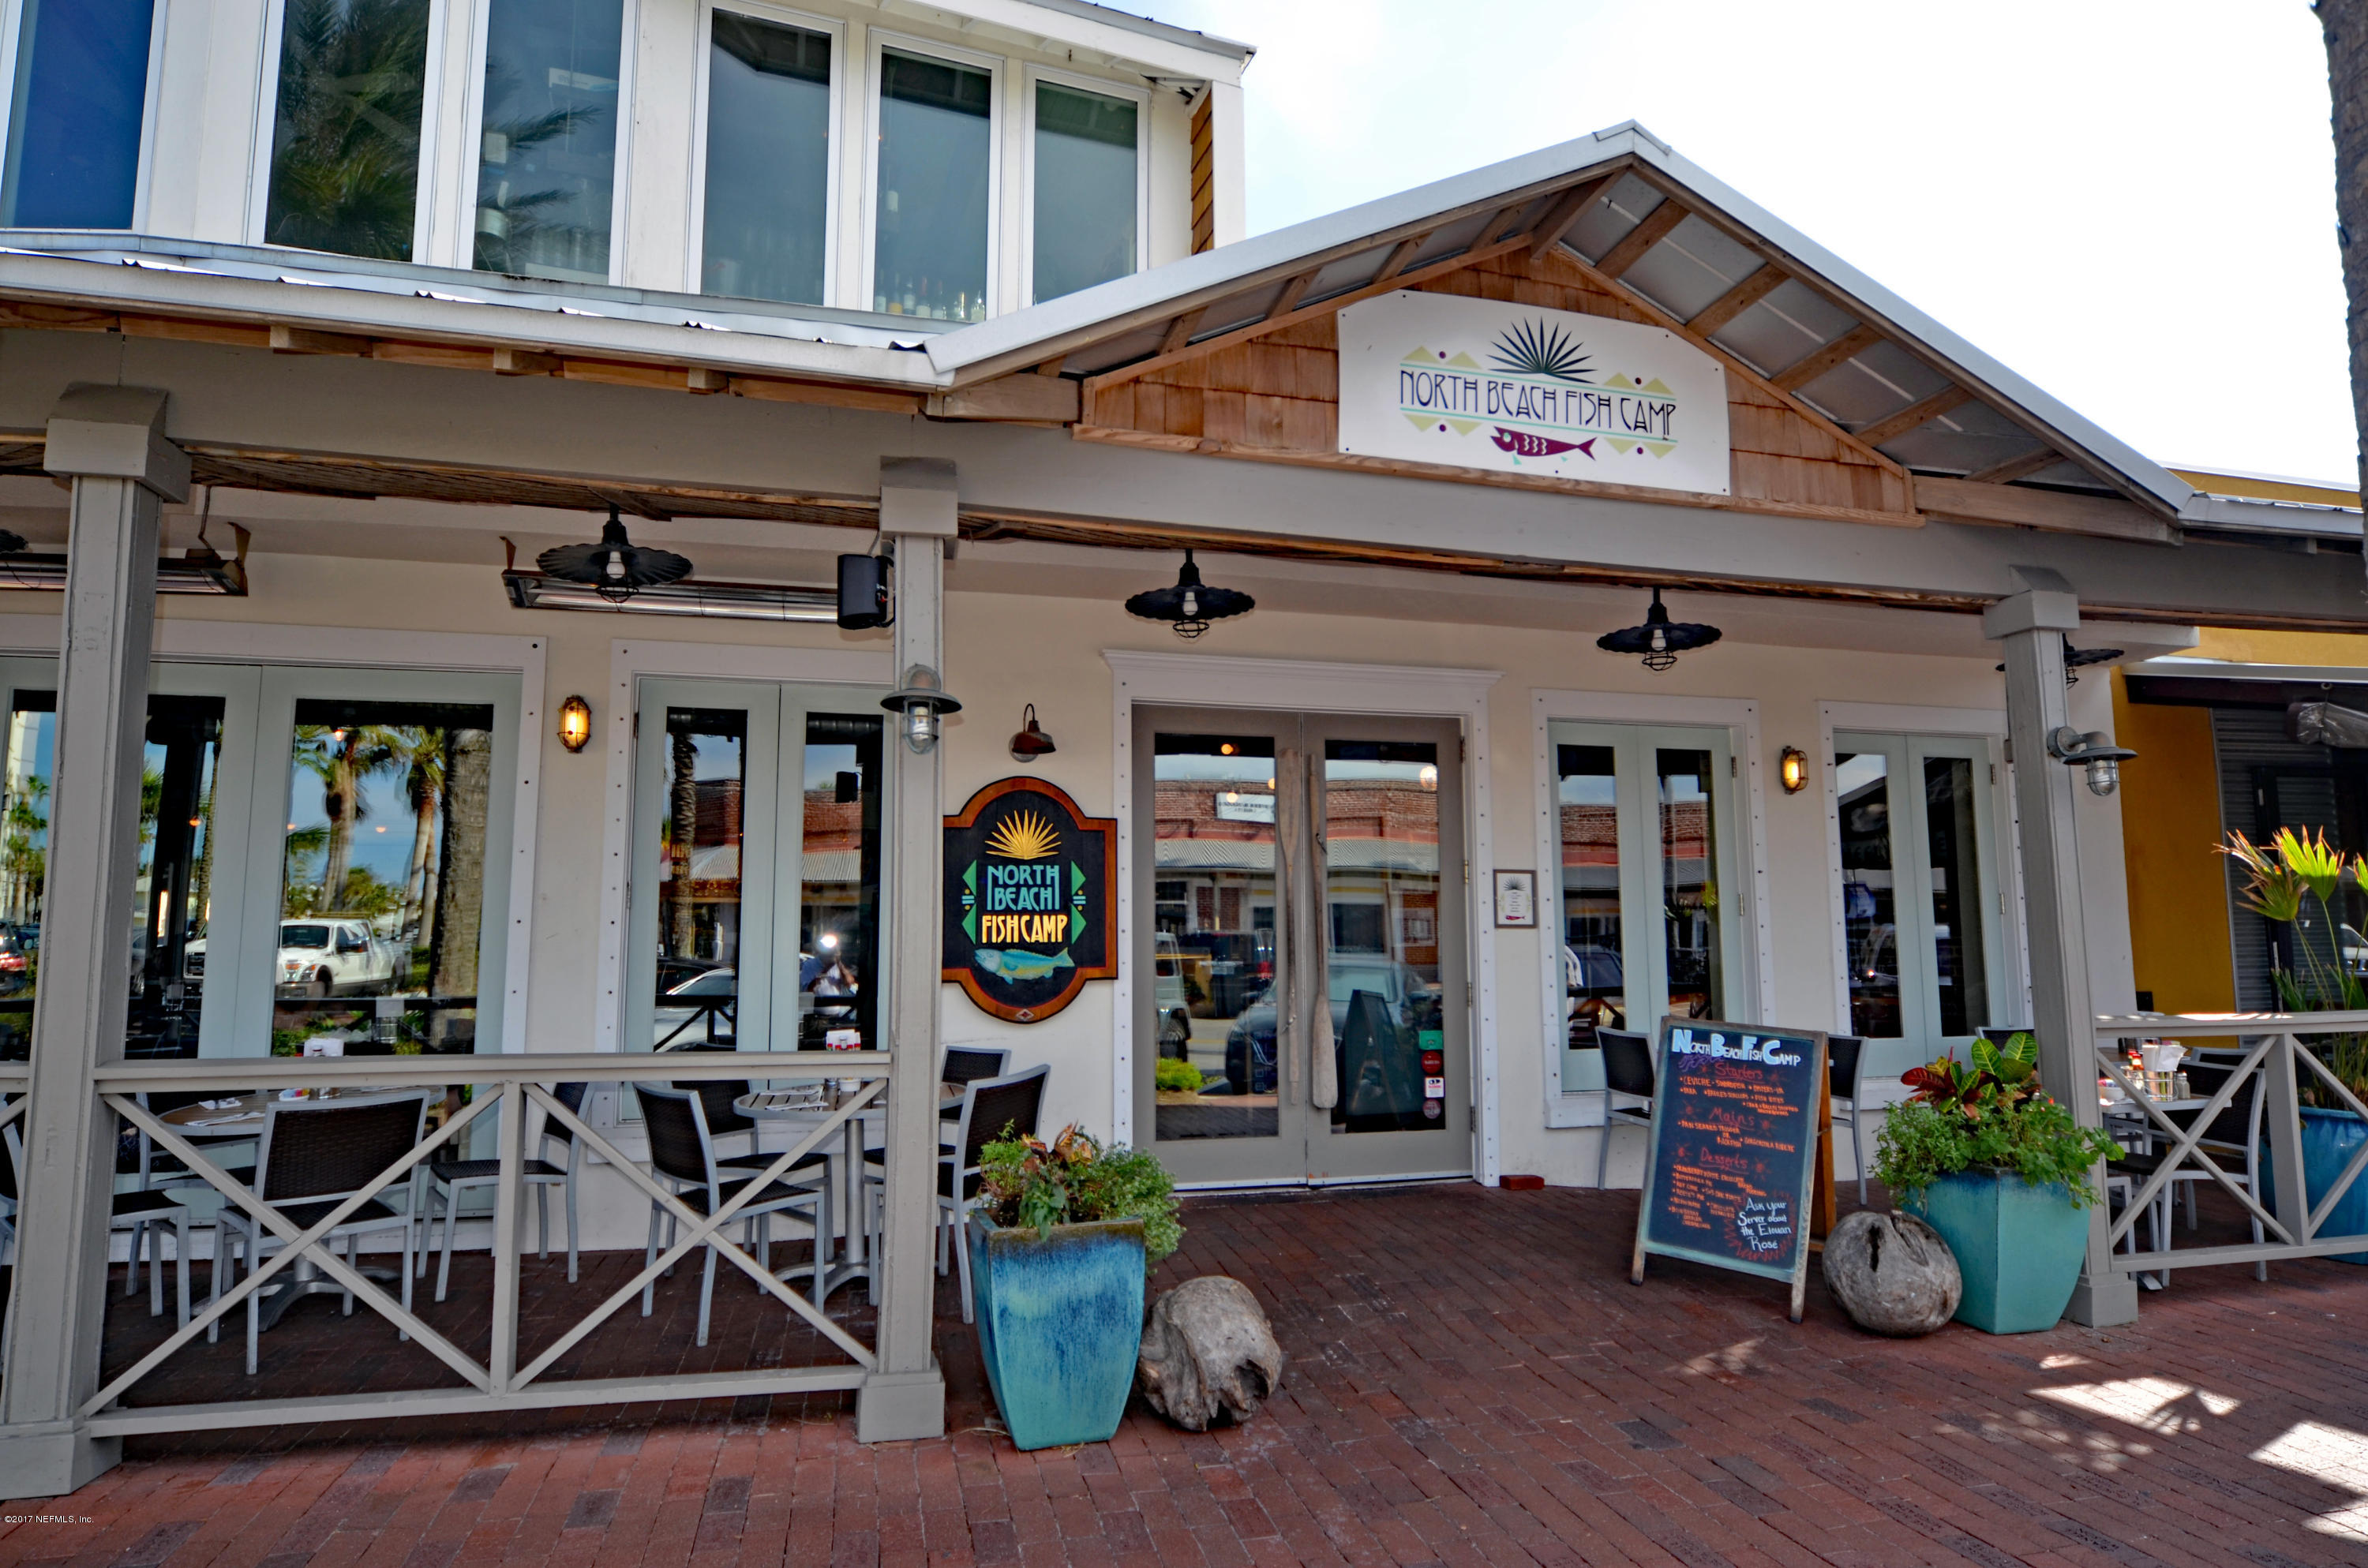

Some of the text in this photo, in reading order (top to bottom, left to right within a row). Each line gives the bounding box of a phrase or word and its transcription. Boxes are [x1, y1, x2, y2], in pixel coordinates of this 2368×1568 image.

[1399, 370, 1677, 436] NORTH BEACH FISH CAMP
[987, 865, 1059, 910] NORTH
[995, 887, 1053, 911] BEACH
[982, 915, 1068, 943] FISH CAMP
[1672, 1028, 1801, 1066] NORTH BEACH FISH CAMP
[1714, 1062, 1763, 1080] Starters
[1709, 1106, 1755, 1125] Mains
[1700, 1147, 1748, 1169] Desserts
[1737, 1211, 1766, 1226] Server
[1767, 1202, 1787, 1216] your
[1740, 1226, 1755, 1236] the
